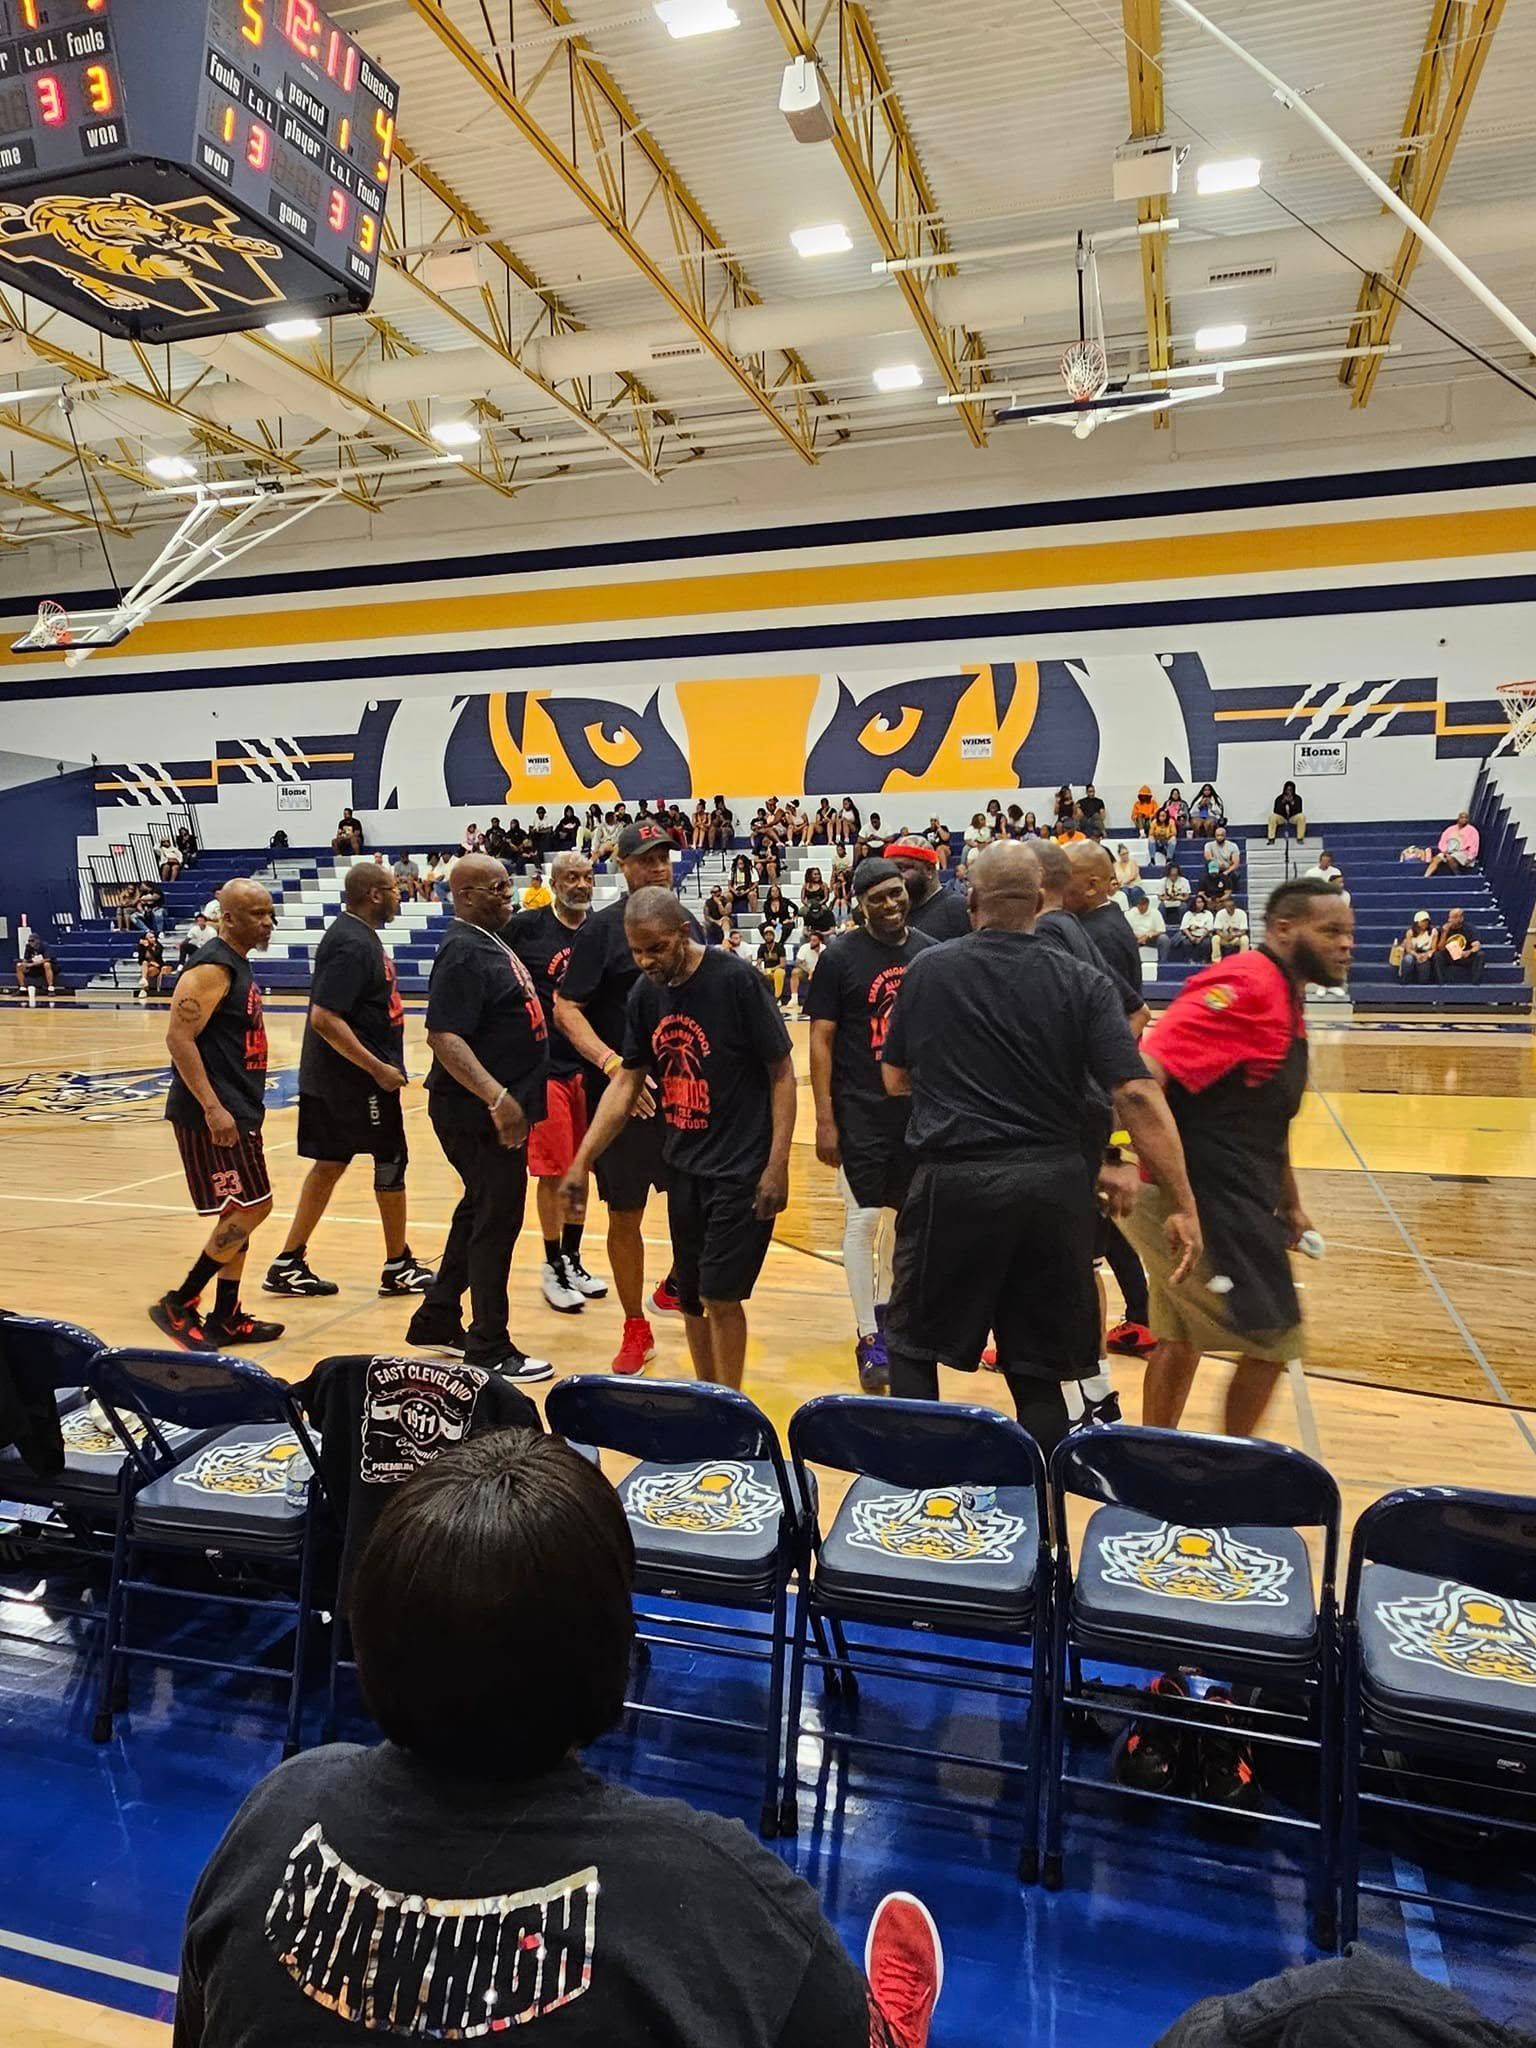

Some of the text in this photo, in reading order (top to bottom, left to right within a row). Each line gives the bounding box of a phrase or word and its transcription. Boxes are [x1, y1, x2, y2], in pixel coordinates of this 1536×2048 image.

[67, 27, 105, 57] fouls
[284, 0, 356, 92] 12:11
[209, 53, 241, 97] fouls
[360, 59, 395, 111] Guests
[37, 65, 112, 122] 3 3
[288, 82, 325, 126] period
[87, 124, 119, 148] won
[223, 107, 233, 142] 1
[284, 118, 321, 158] player
[339, 118, 349, 150] 1
[375, 108, 393, 159] 4
[203, 144, 229, 177] won
[249, 125, 268, 168] 3
[329, 189, 345, 230] 3
[357, 177, 380, 212] fouls
[278, 201, 307, 236] game
[359, 213, 375, 253] 3
[351, 253, 371, 281] won
[1301, 746, 1341, 757] Home
[281, 787, 307, 796] Home
[211, 1170, 243, 1197] 23
[374, 1365, 406, 1385] EAST
[407, 1365, 473, 1401] CLEVELAND
[403, 1407, 436, 1434] 1911
[371, 1462, 415, 1472] PREMIUM
